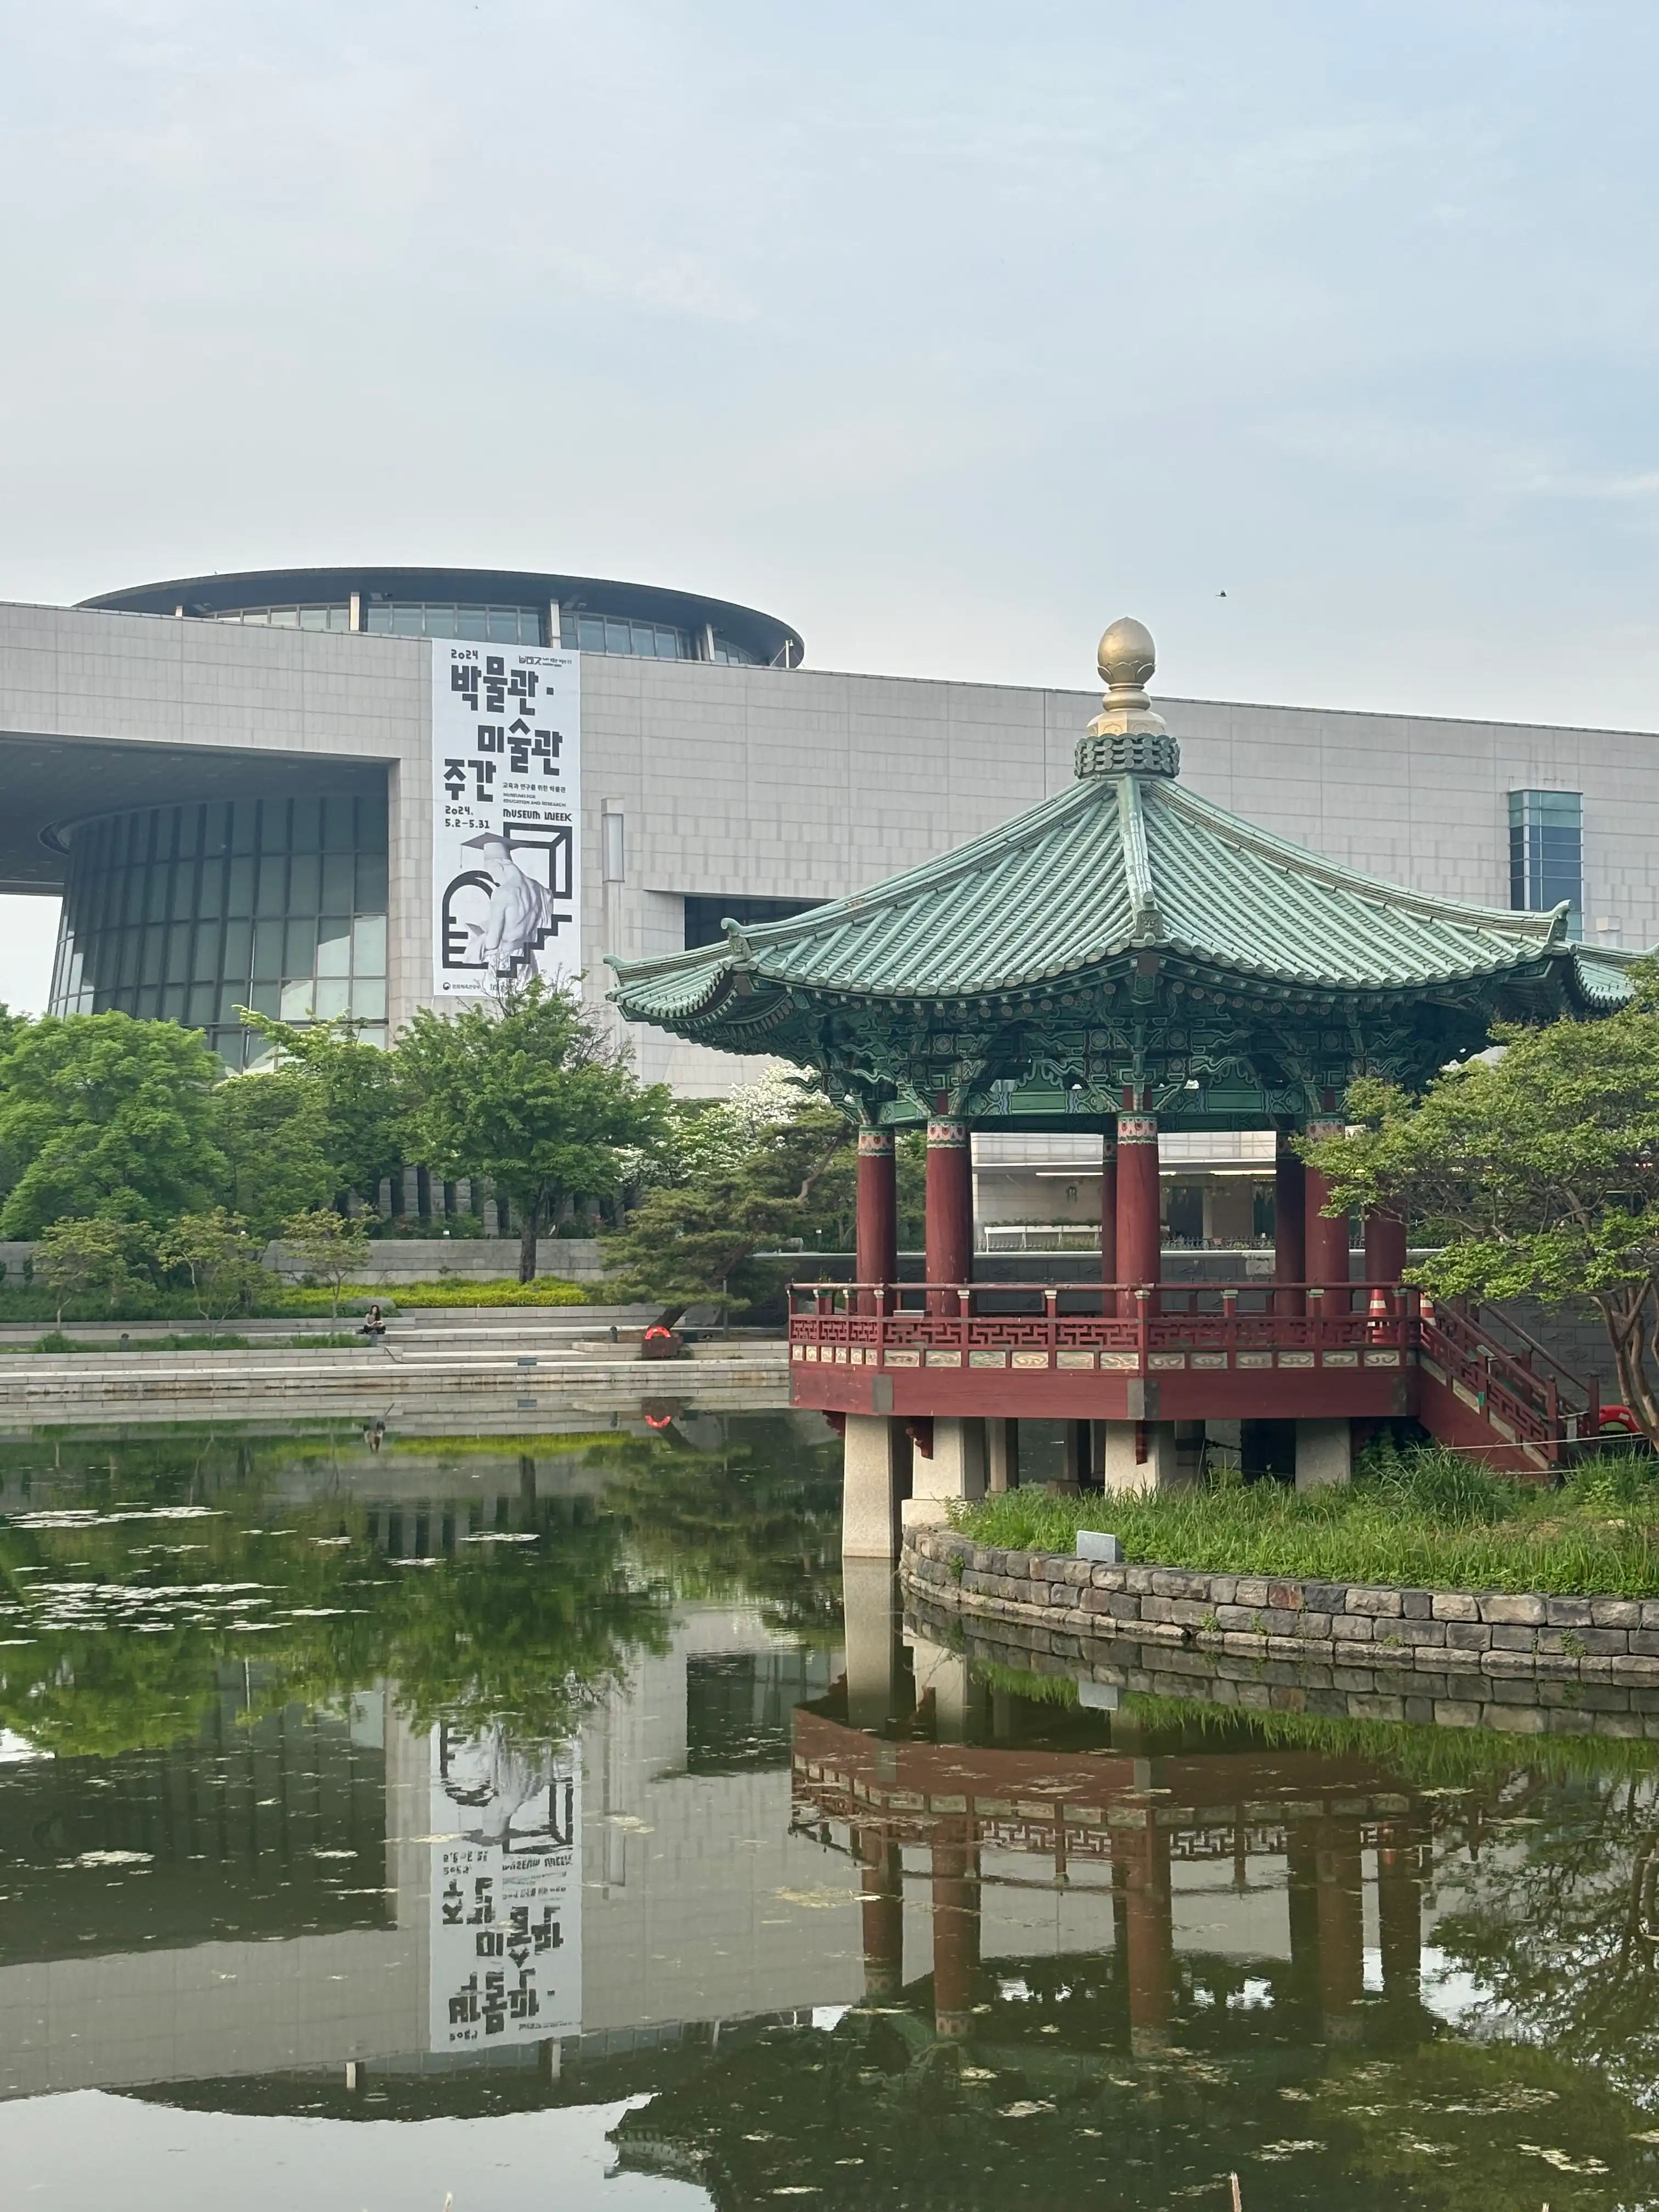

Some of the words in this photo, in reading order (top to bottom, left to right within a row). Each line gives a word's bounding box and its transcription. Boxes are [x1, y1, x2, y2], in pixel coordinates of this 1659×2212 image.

[451, 649, 478, 660] 2024
[478, 718, 563, 776] 미술관
[443, 758, 496, 802] 주간
[445, 805, 474, 815] 2024.
[503, 808, 540, 820] MUSEUM
[544, 811, 573, 822] WEEK
